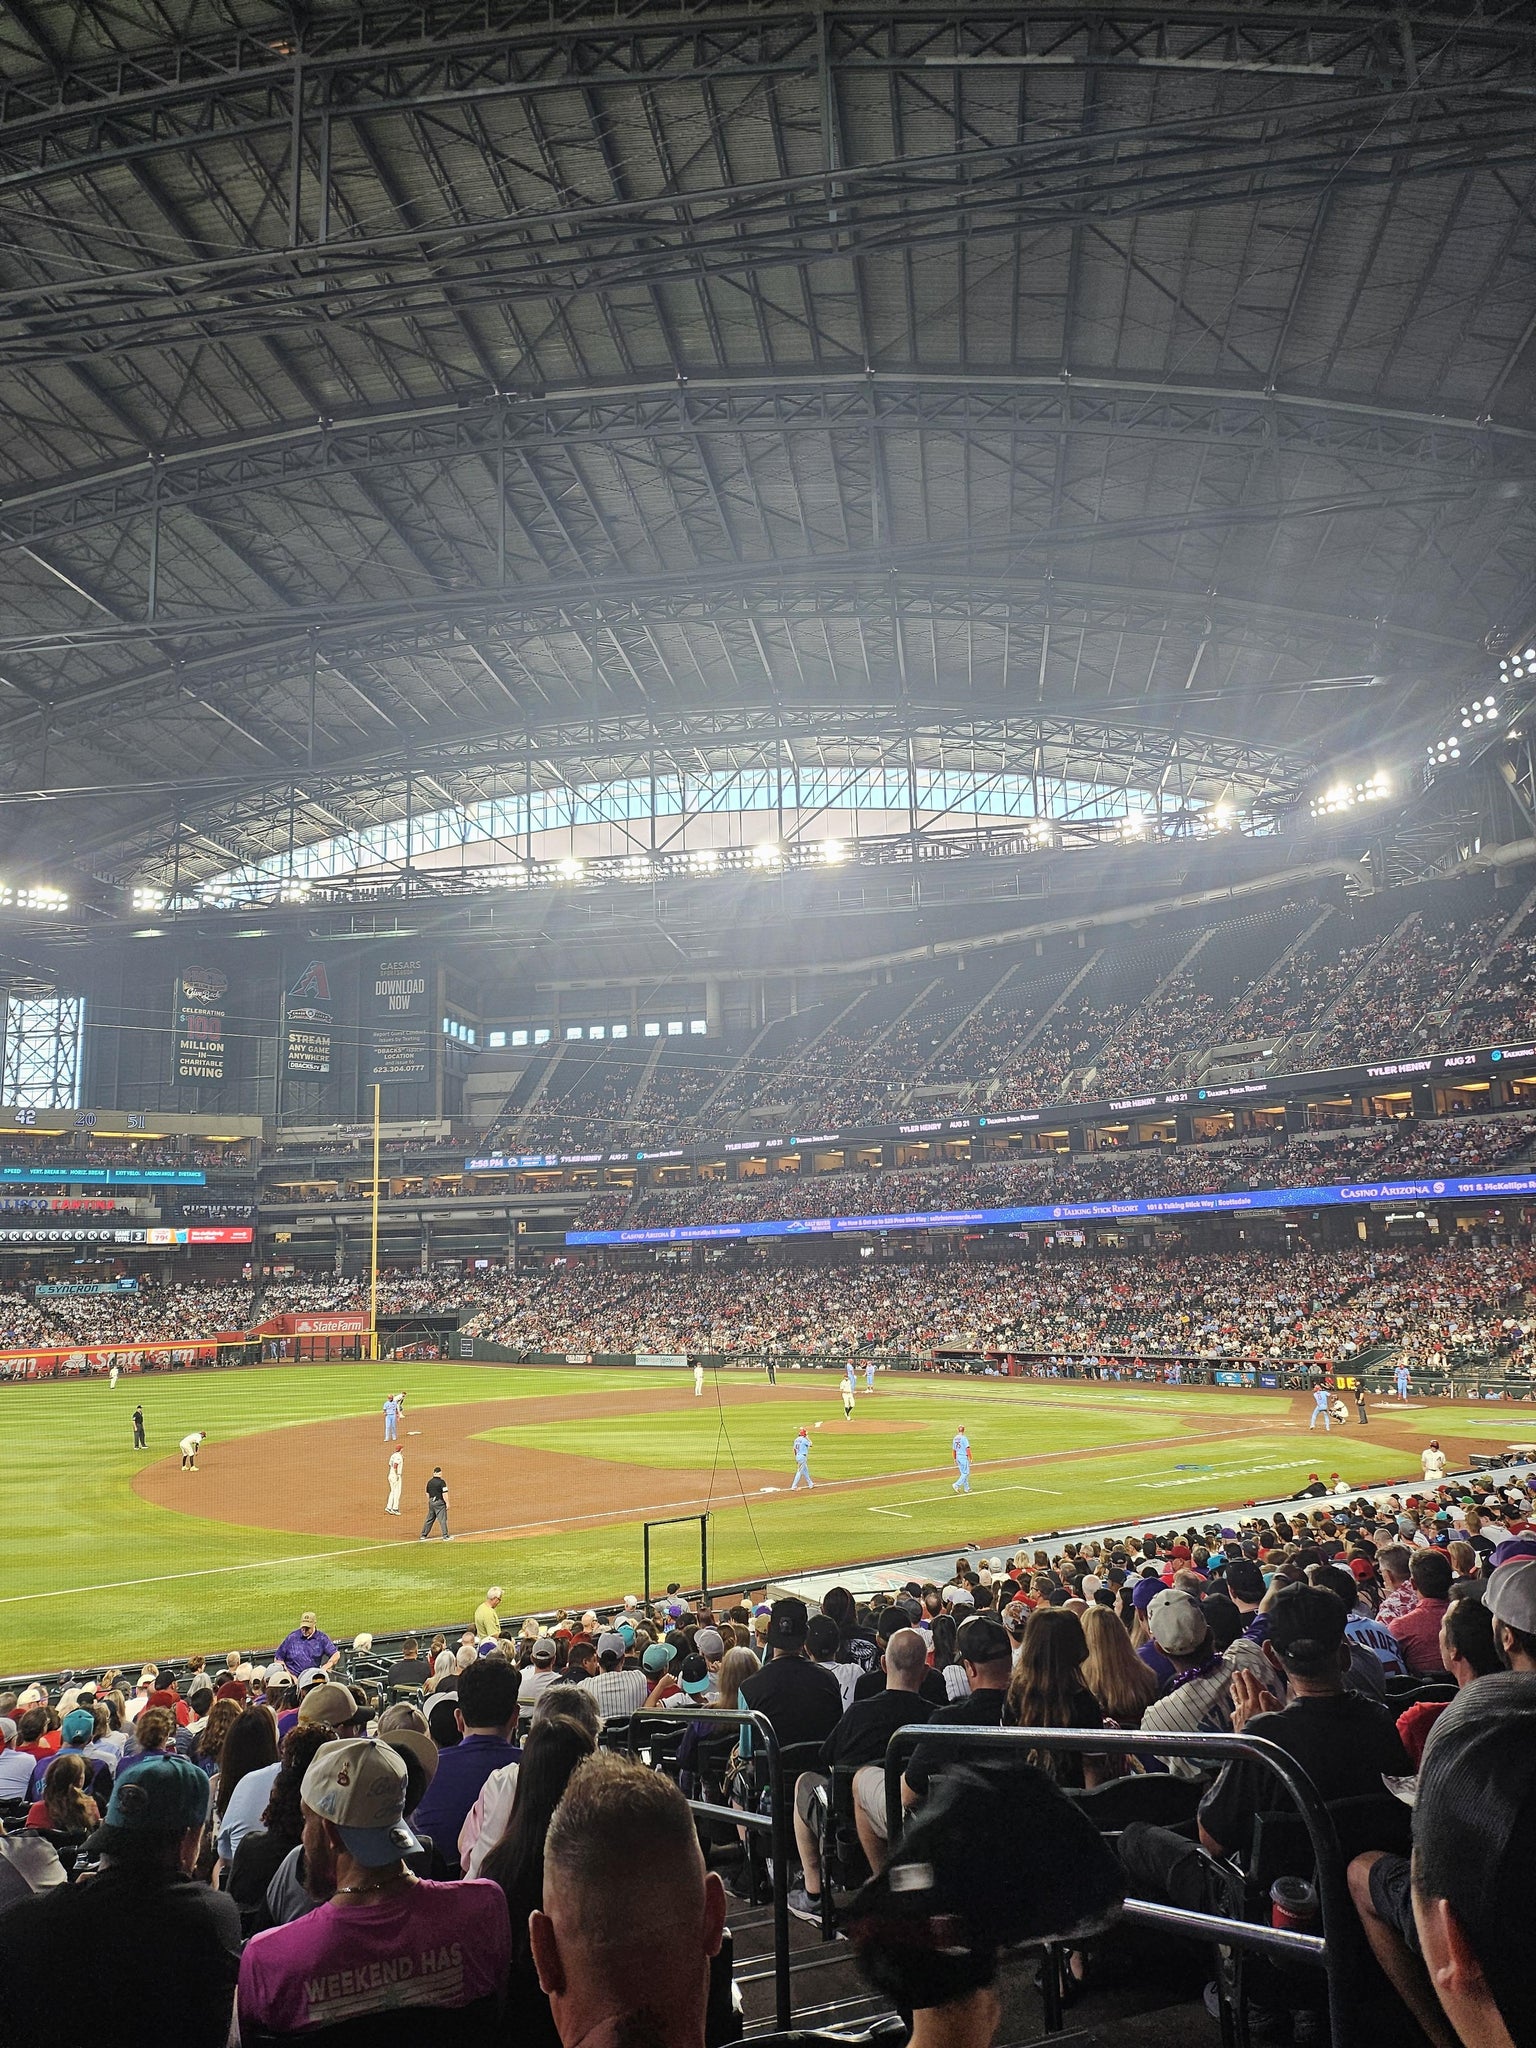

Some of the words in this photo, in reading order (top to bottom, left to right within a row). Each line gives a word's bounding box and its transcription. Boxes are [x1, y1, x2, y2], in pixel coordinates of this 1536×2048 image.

[380, 961, 421, 970] CAESARS
[376, 979, 424, 996] DOWNLOAD
[389, 995, 410, 1010] NOW
[182, 1008, 225, 1016] CELEBRATING
[289, 1034, 330, 1046] STREAM
[180, 1040, 224, 1052] MILLION
[289, 1044, 306, 1052] ANY
[308, 1046, 330, 1054] GAME
[289, 1052, 330, 1062] ANYWHERE
[1501, 1049, 1534, 1058] TALKING
[180, 1058, 224, 1067] CHARITABLE
[1444, 1057, 1466, 1067] AUG
[1466, 1055, 1476, 1064] 21
[180, 1066, 223, 1078] GIVING
[373, 1065, 424, 1073] 623.304.0777
[1367, 1066, 1400, 1077] TYLER
[1400, 1061, 1431, 1073] HENRY
[1246, 1084, 1267, 1092] RESORT
[1109, 1102, 1132, 1110] TYLER
[1132, 1098, 1156, 1107] HENRY
[1165, 1095, 1179, 1103] AUG
[14, 1109, 36, 1125] 42
[73, 1111, 96, 1127] 20
[127, 1113, 145, 1129] 51
[900, 1125, 919, 1133] TYLER
[920, 1123, 941, 1131] HENRY
[490, 1159, 504, 1167] PM
[1341, 1188, 1378, 1198] CASINO
[1380, 1185, 1430, 1196] ARIZONA
[1458, 1184, 1474, 1192] 101
[1484, 1181, 1528, 1191] McKellips
[1218, 1198, 1251, 1206] Scottsdale
[1063, 1207, 1091, 1216] TALKING
[1092, 1206, 1112, 1214] STICK
[1112, 1204, 1138, 1212] RESORT
[134, 1232, 142, 1240] 3
[48, 1285, 98, 1293] SYNCRON
[303, 1956, 413, 2002] WEEKEND
[420, 1943, 463, 1973] HAS
